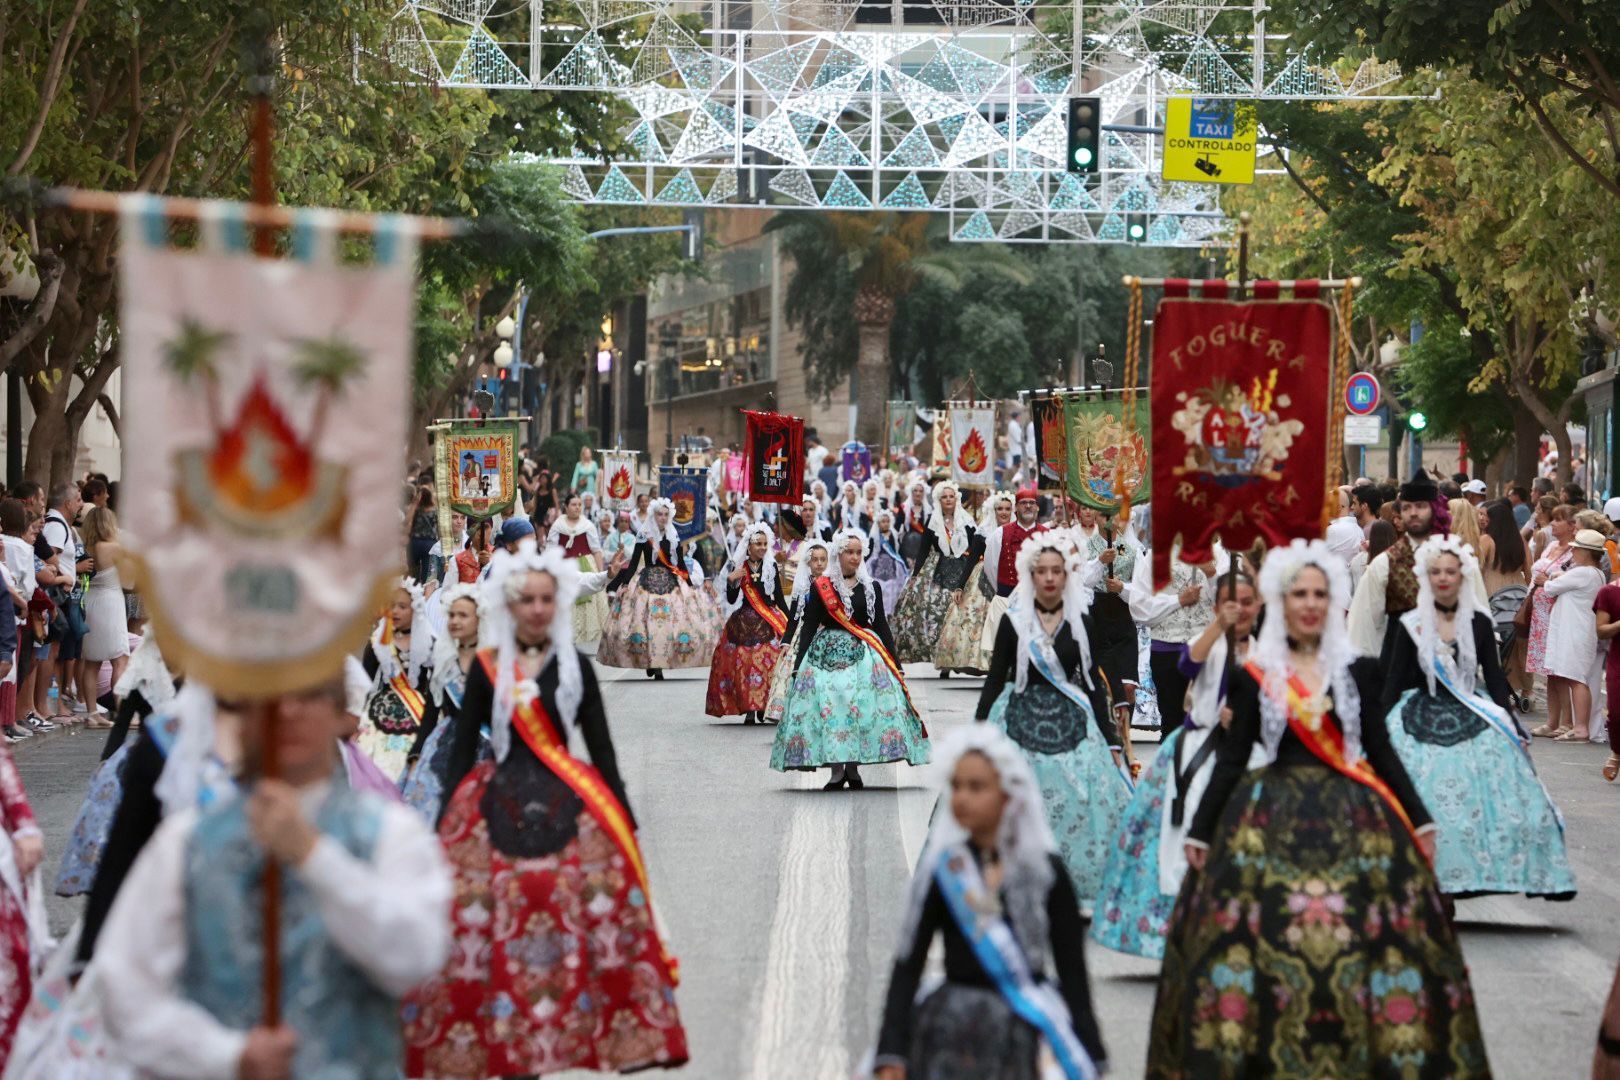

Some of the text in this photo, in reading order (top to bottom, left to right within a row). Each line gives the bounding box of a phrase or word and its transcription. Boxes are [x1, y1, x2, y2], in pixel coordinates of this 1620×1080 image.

[1196, 123, 1228, 136] TAXI
[1169, 138, 1252, 152] CONTROLADO
[1169, 321, 1305, 371] FOGUERA
[1175, 481, 1299, 528] RABASSA
